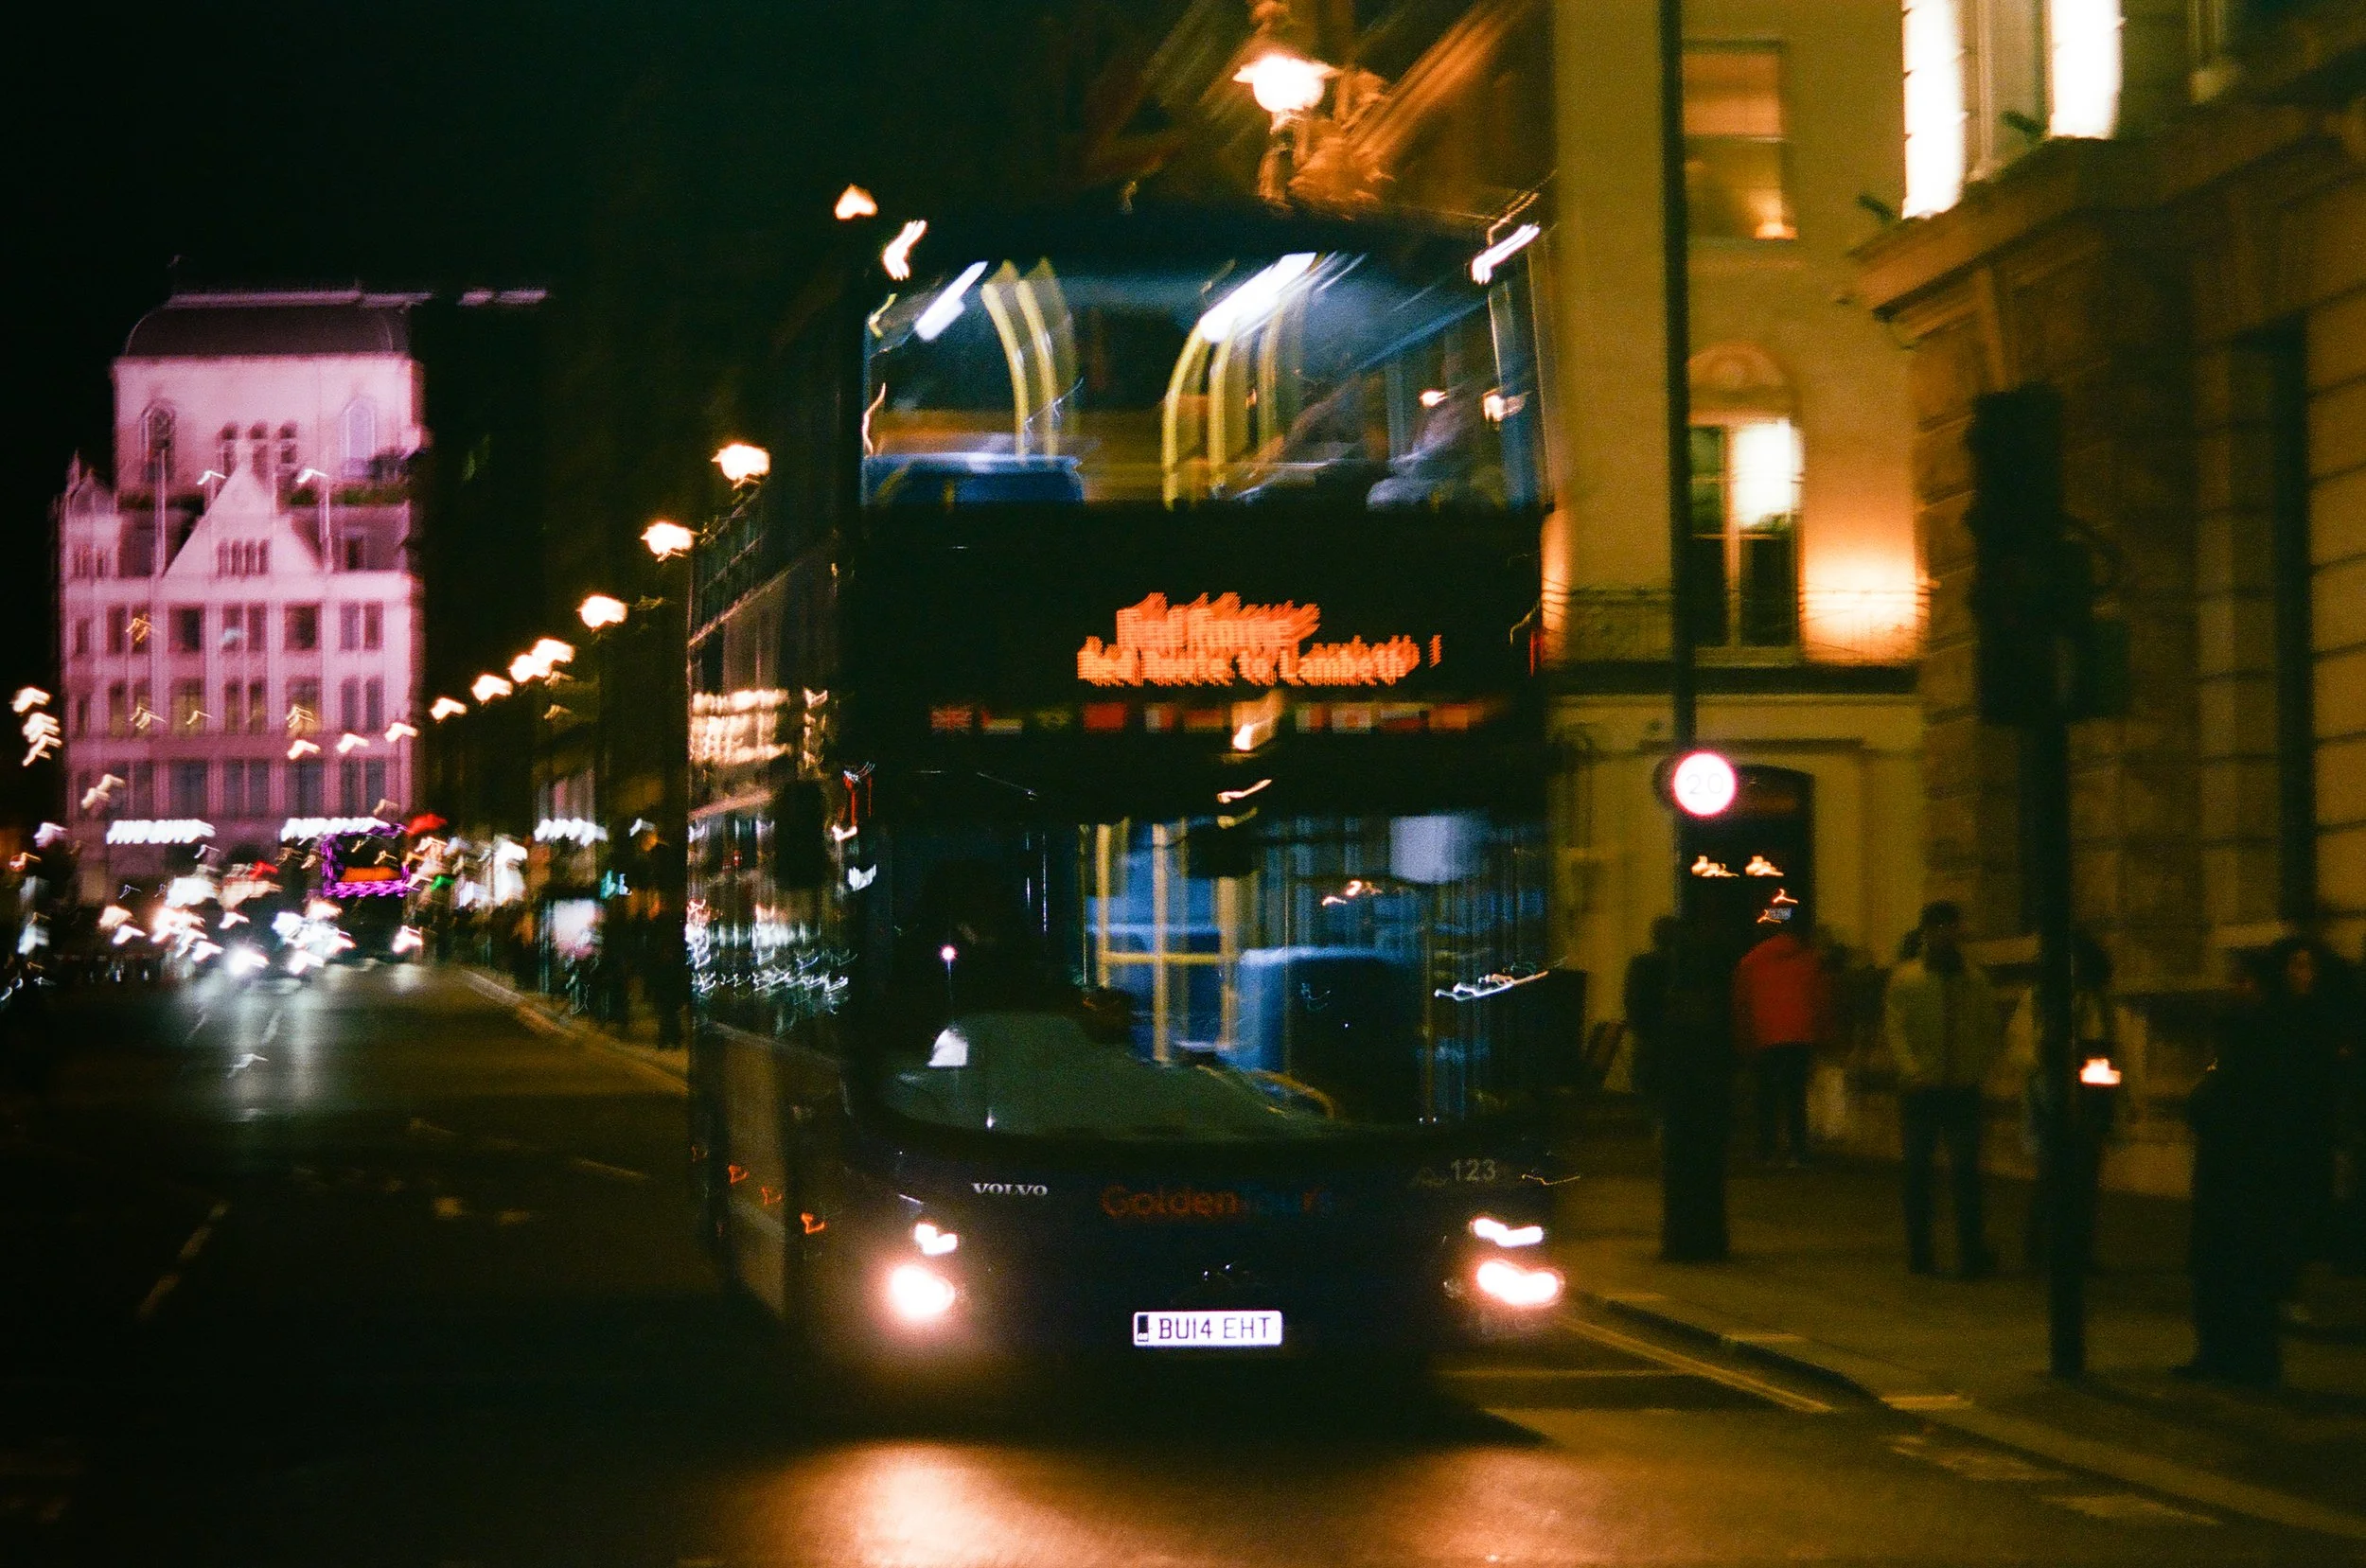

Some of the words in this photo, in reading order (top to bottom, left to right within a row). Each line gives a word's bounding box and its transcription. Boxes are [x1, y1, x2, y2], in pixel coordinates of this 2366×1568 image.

[1686, 772, 1724, 795] 20
[1450, 1157, 1497, 1183] 123
[970, 1181, 1049, 1197] VOLVO
[1158, 1316, 1214, 1340] BU14
[1223, 1316, 1272, 1340] EHT
